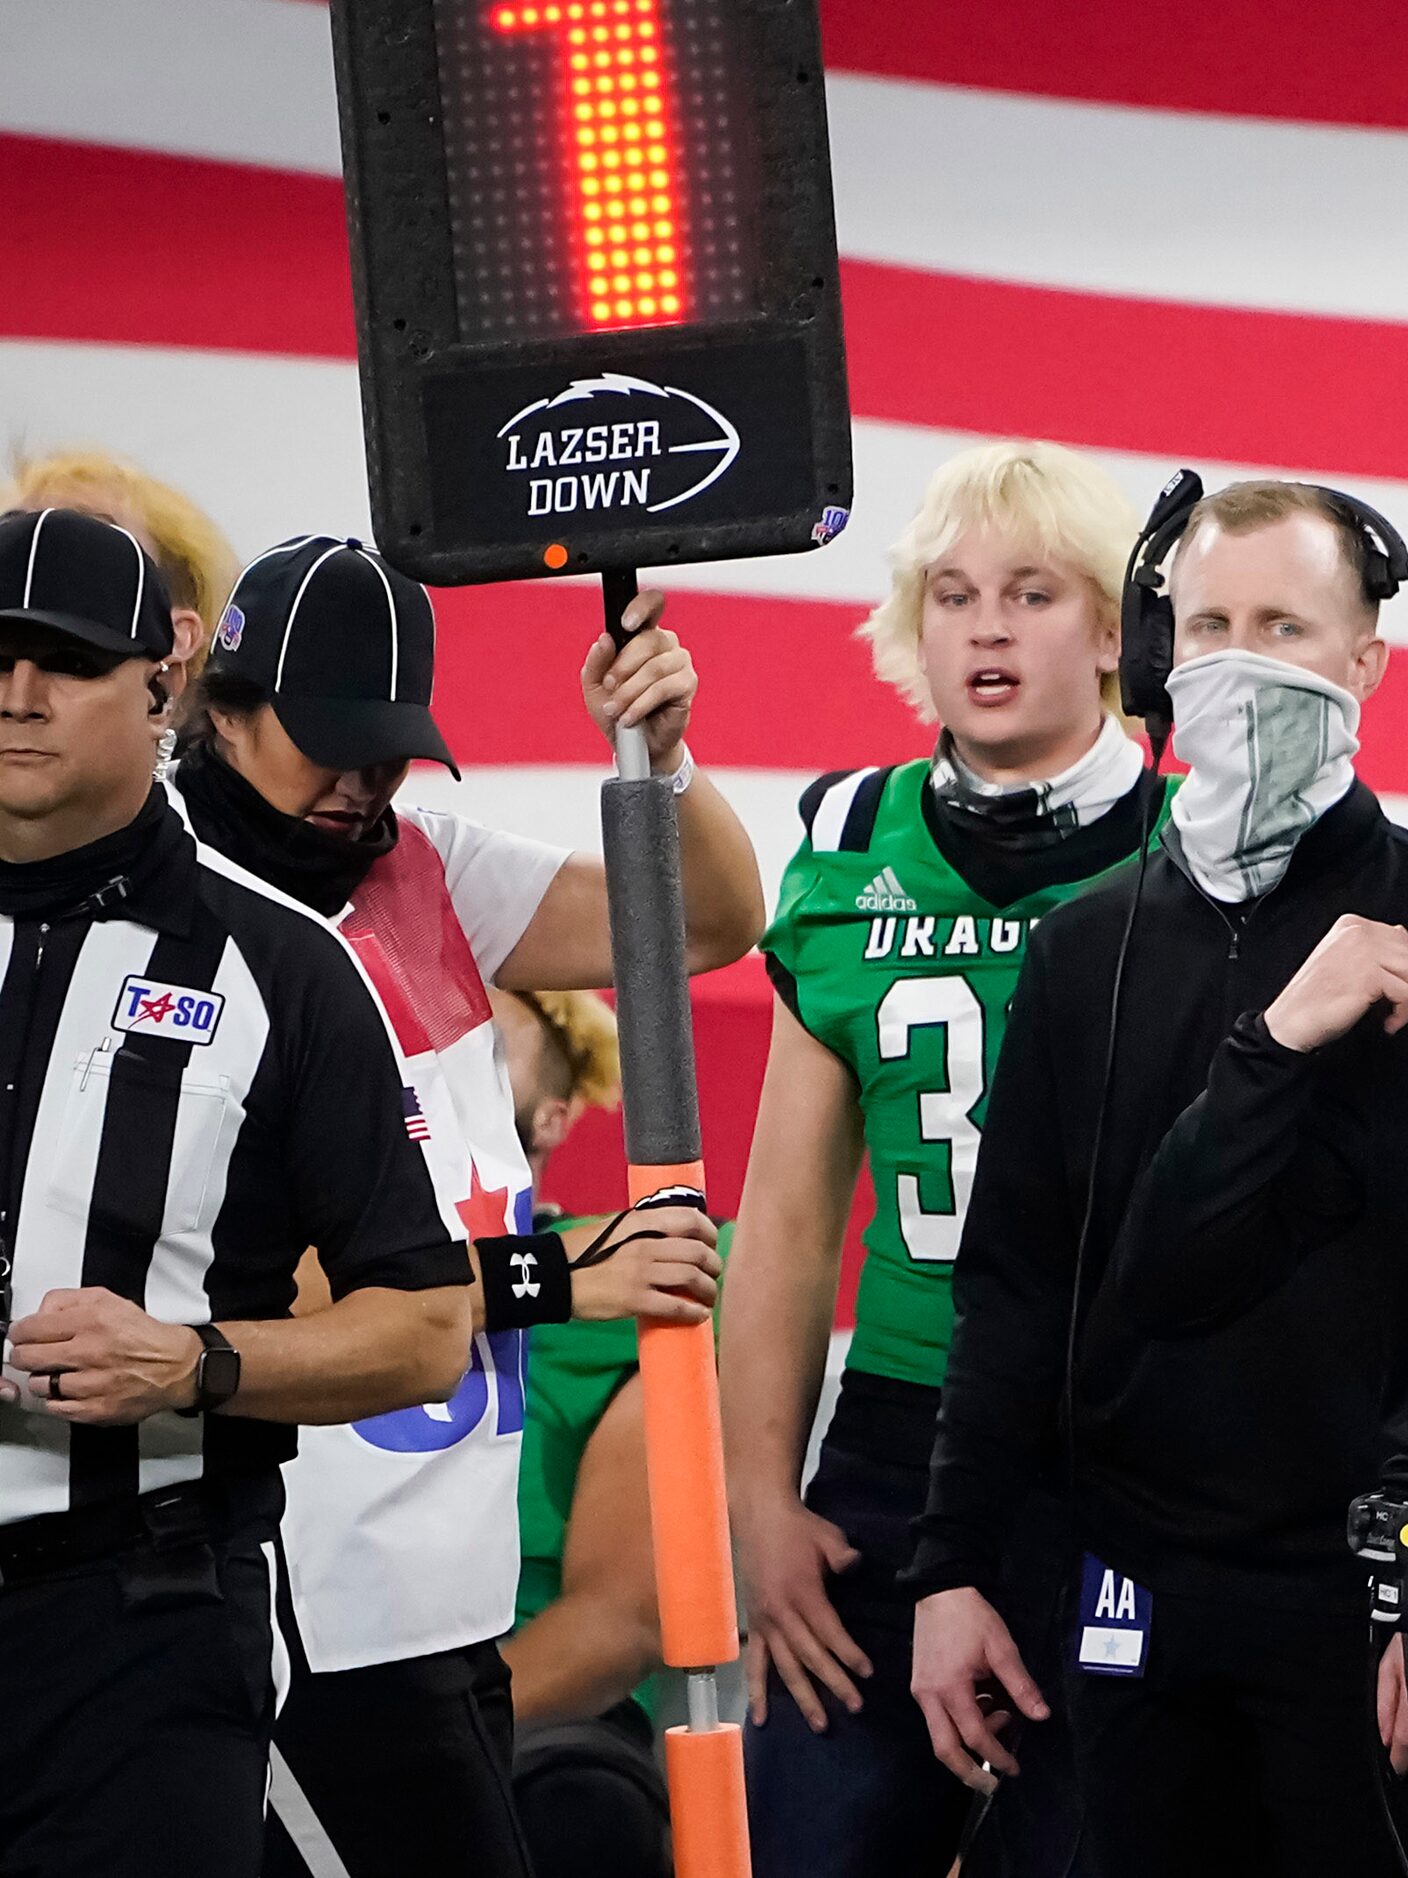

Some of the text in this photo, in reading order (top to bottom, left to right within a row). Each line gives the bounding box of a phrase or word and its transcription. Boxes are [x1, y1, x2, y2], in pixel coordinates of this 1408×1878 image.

[488, 0, 685, 333] 1
[505, 419, 662, 472] LAZSER
[526, 468, 652, 516] DOWN
[855, 894, 918, 912] adidas
[863, 913, 1042, 960] DRAG
[1094, 1567, 1136, 1621] AA
